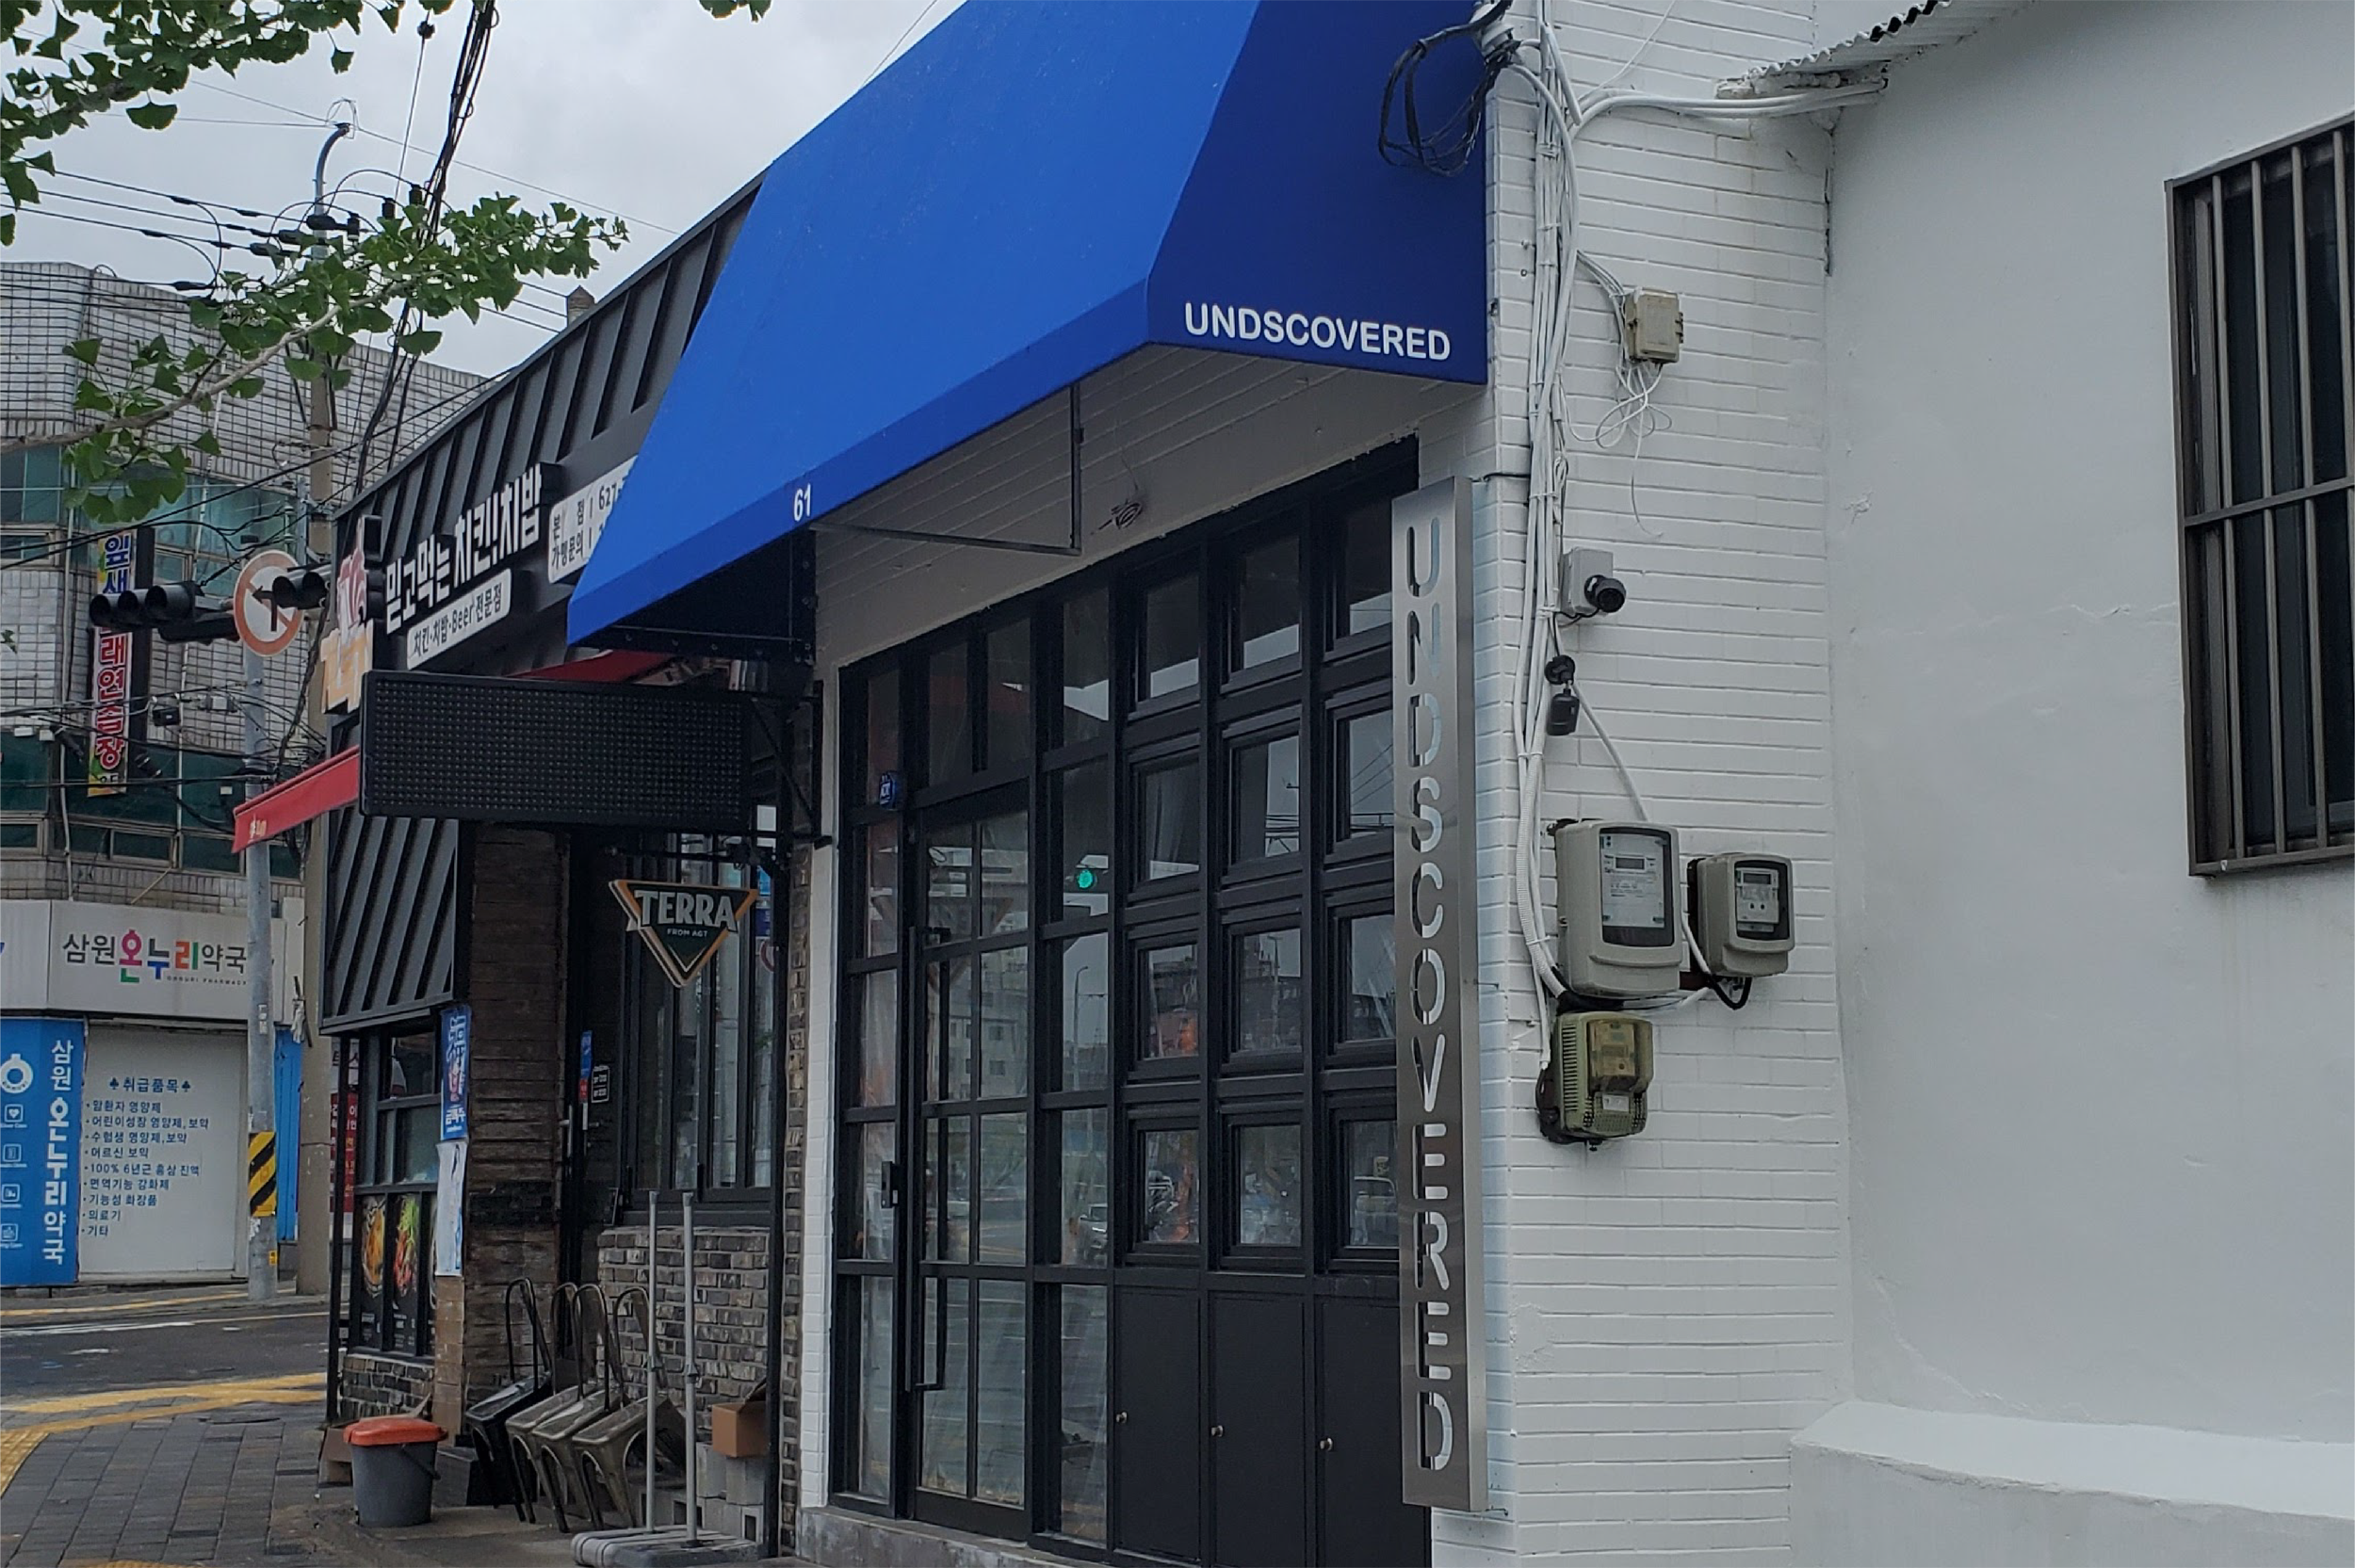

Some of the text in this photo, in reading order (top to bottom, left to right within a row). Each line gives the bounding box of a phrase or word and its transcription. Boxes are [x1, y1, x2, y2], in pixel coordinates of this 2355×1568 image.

[1184, 301, 1452, 362] UNDSCOVERED
[793, 482, 811, 523] 61
[95, 627, 127, 770] 래연습장
[634, 890, 738, 931] TERRA
[667, 928, 690, 936] FROM
[1406, 516, 1453, 1472] UNDSCOVERED
[129, 1101, 161, 1114] 영양제
[90, 1164, 120, 1173] 100%
[88, 1225, 108, 1237] 기타
